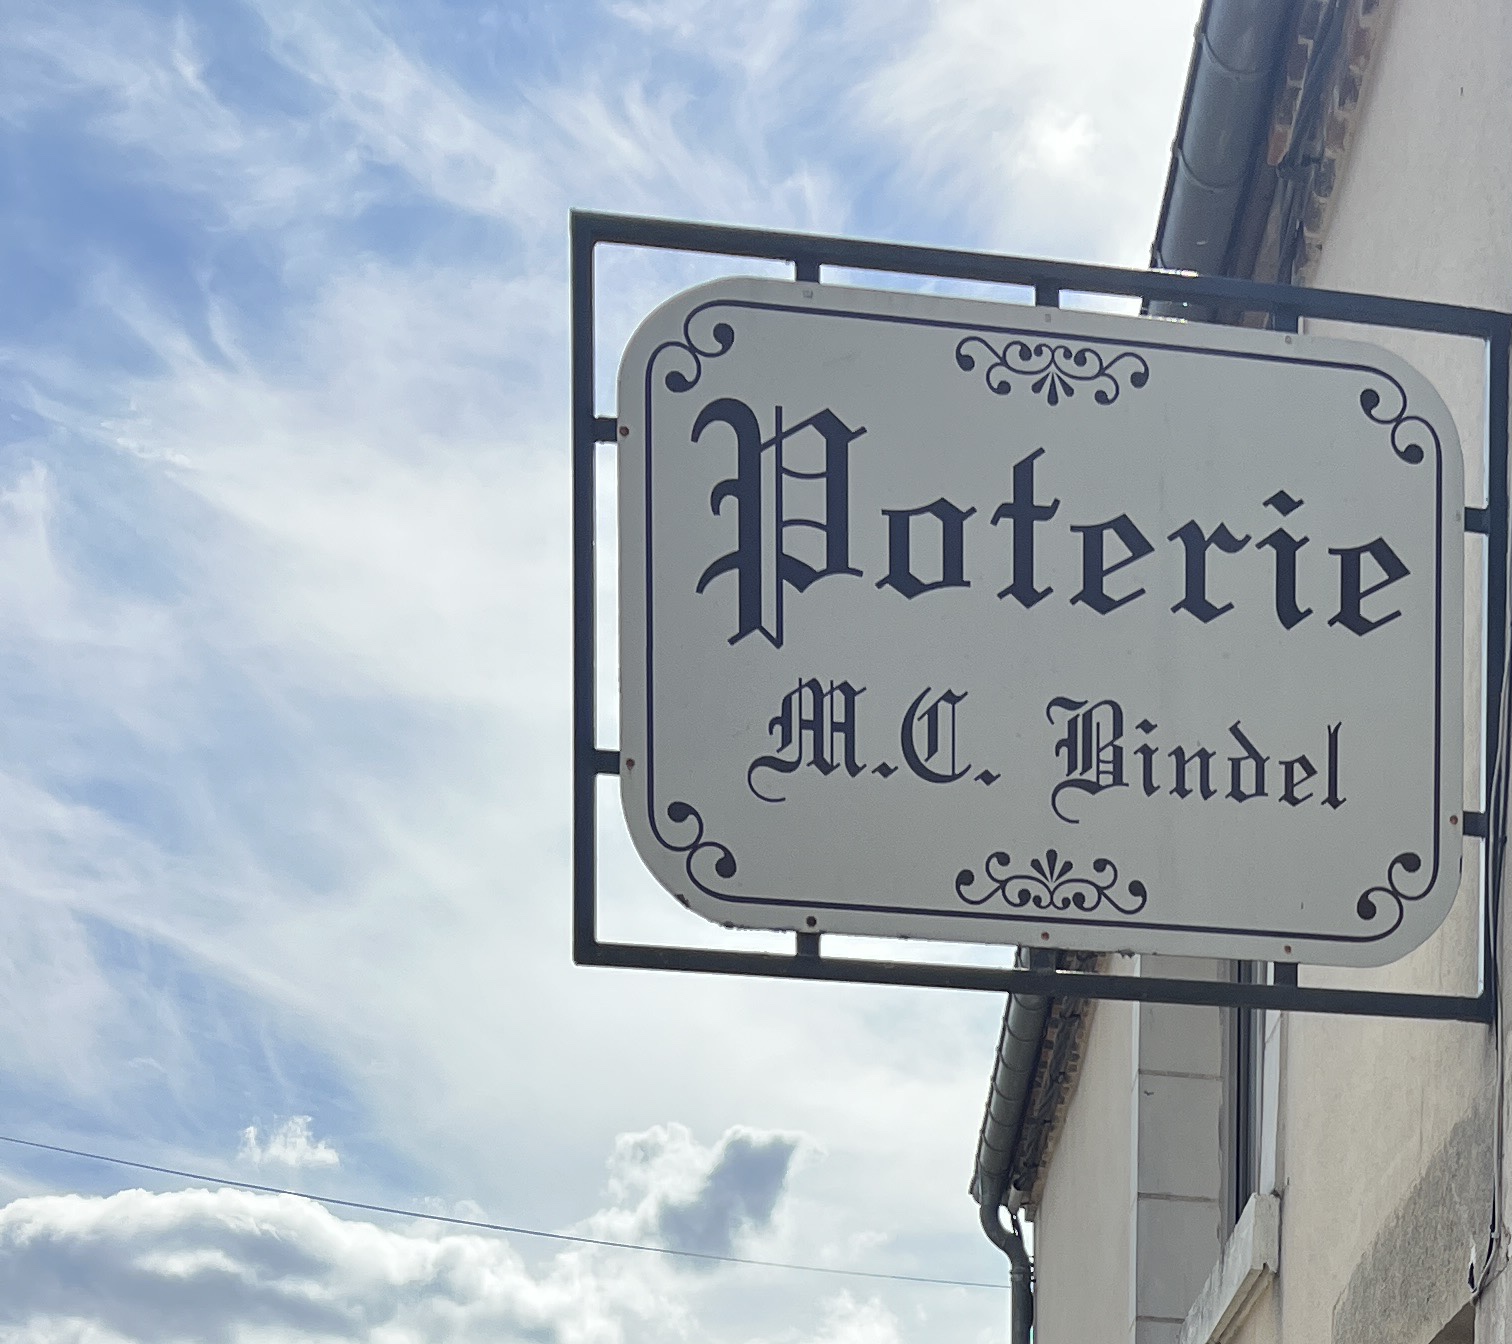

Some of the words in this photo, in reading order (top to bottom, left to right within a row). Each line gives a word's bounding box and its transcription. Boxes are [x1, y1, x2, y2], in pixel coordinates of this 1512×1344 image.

[690, 397, 1412, 649] Poterie
[747, 677, 1001, 802] M.C.
[1045, 697, 1348, 824] Bindel
